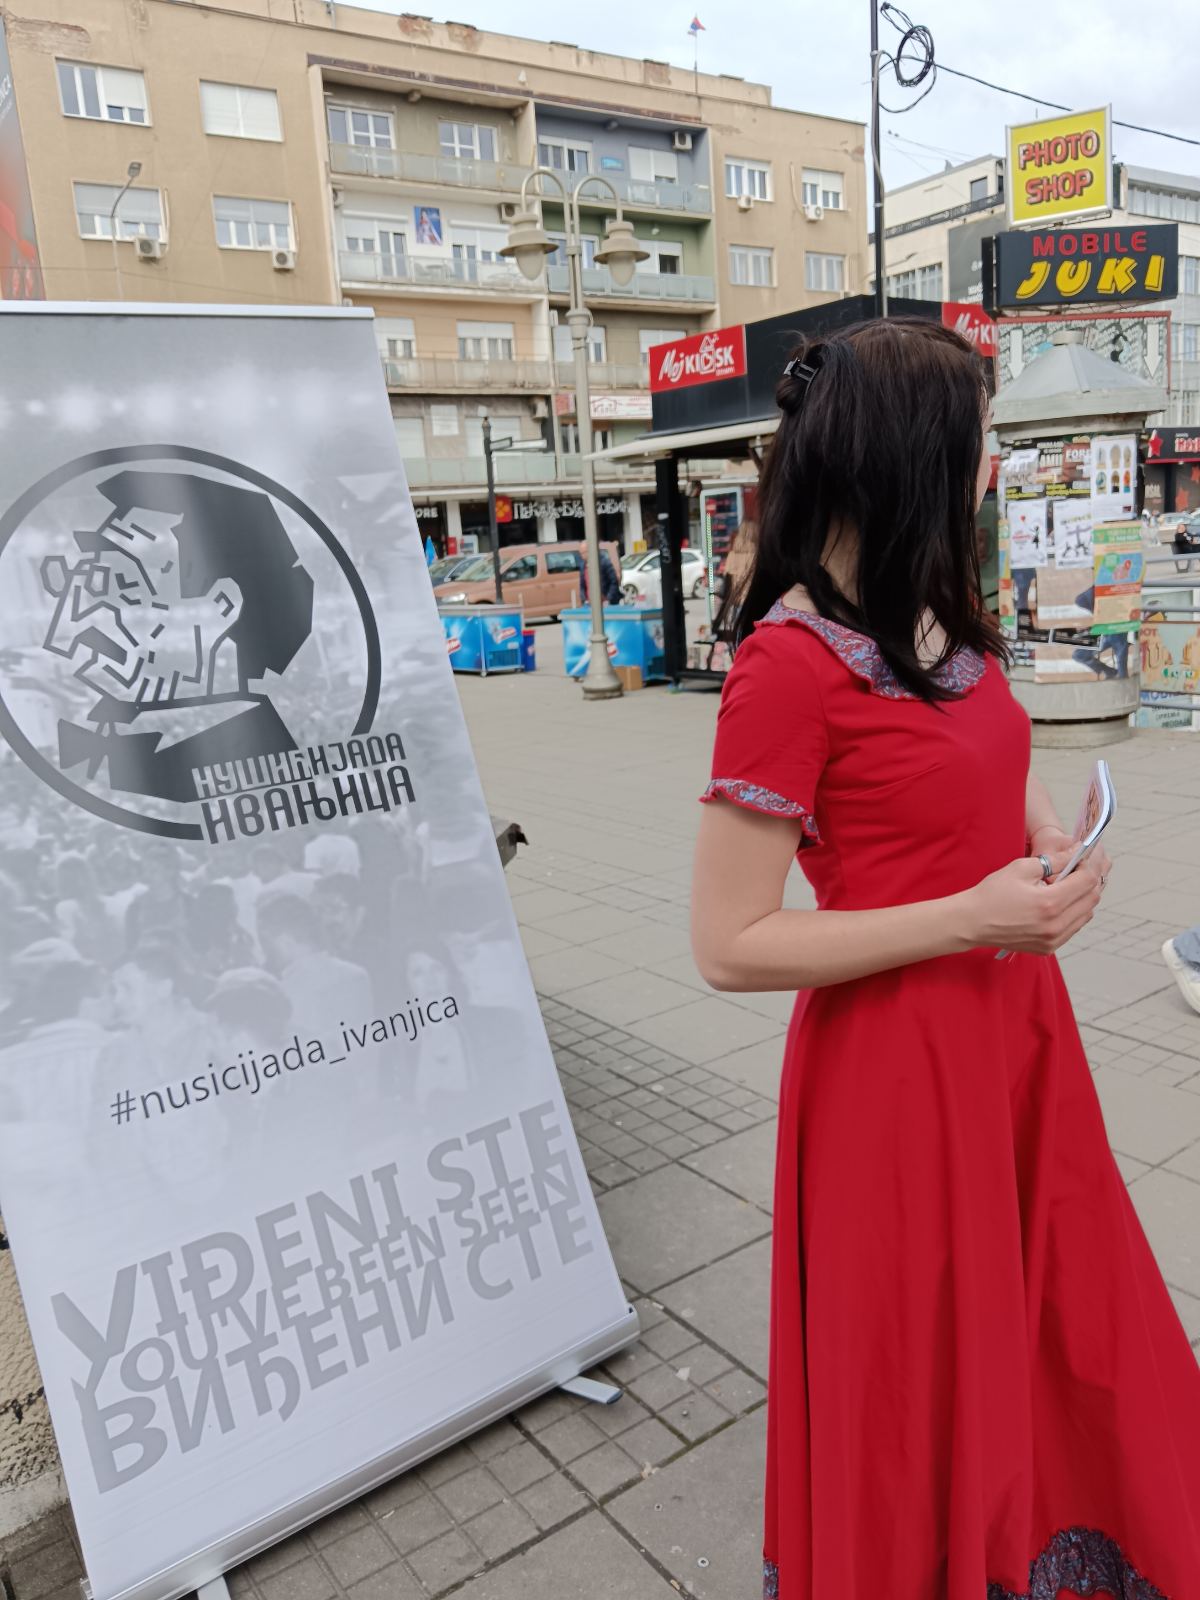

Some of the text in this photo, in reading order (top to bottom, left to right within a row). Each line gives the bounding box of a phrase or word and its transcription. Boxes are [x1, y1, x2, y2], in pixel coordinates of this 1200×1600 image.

[1018, 130, 1100, 171] PHOTO
[1025, 169, 1093, 205] SHOP
[1033, 231, 1147, 257] MOBILE
[1015, 255, 1165, 299] JUKI
[685, 335, 735, 375] KIOSK
[201, 765, 416, 844] ИВАЊИЦА
[110, 995, 460, 1126] #nusicijada_ivanjica
[426, 1099, 568, 1213] STE
[315, 1215, 446, 1310] BEEN
[453, 1149, 581, 1247] SEEN
[81, 1200, 595, 1494] ВИЂЕНИ СТЕ
